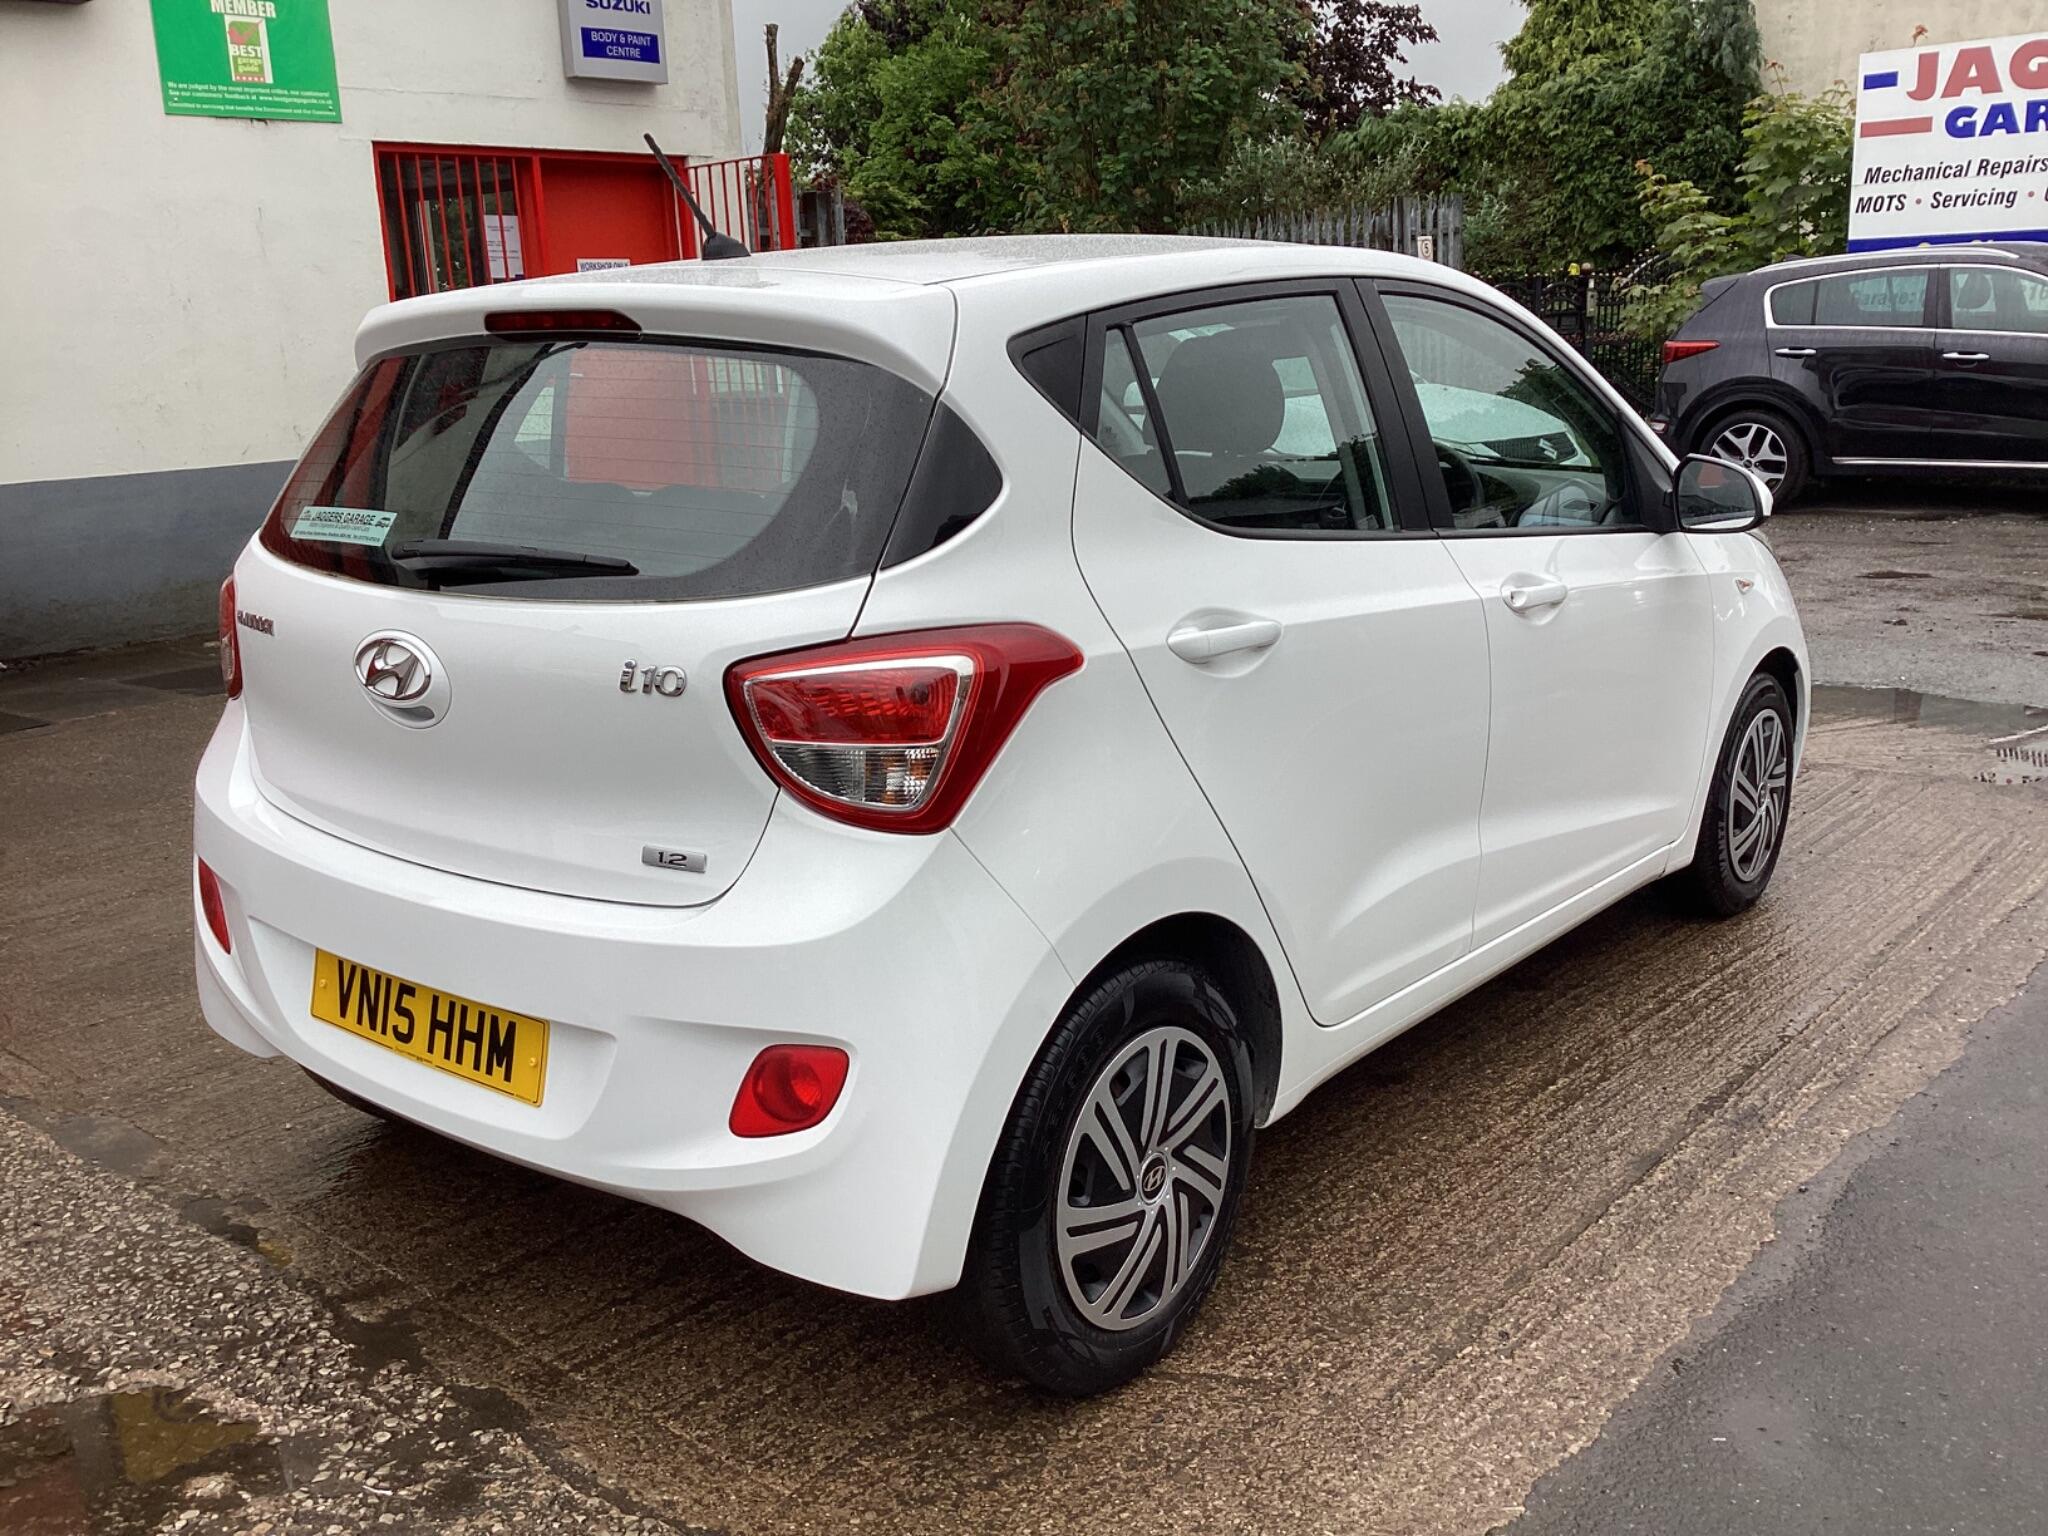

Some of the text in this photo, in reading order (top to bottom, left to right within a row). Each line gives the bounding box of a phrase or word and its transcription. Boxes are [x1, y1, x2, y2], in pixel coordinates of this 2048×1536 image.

[210, 0, 276, 18] MEMBER
[585, 0, 651, 15] SUZUKI
[591, 31, 651, 46] BODY & PAINT
[230, 43, 262, 57] BEST
[606, 45, 641, 58] CENTRE
[1944, 99, 2048, 139] GAR
[1864, 154, 2048, 185] Mechanical Repairs
[1855, 193, 1907, 214] MOTS
[1930, 188, 2018, 210] Servicing
[344, 512, 376, 526] GARAGE
[619, 658, 687, 697] i10
[657, 850, 687, 867] 1.2
[337, 959, 517, 1084] VN15 HHM
